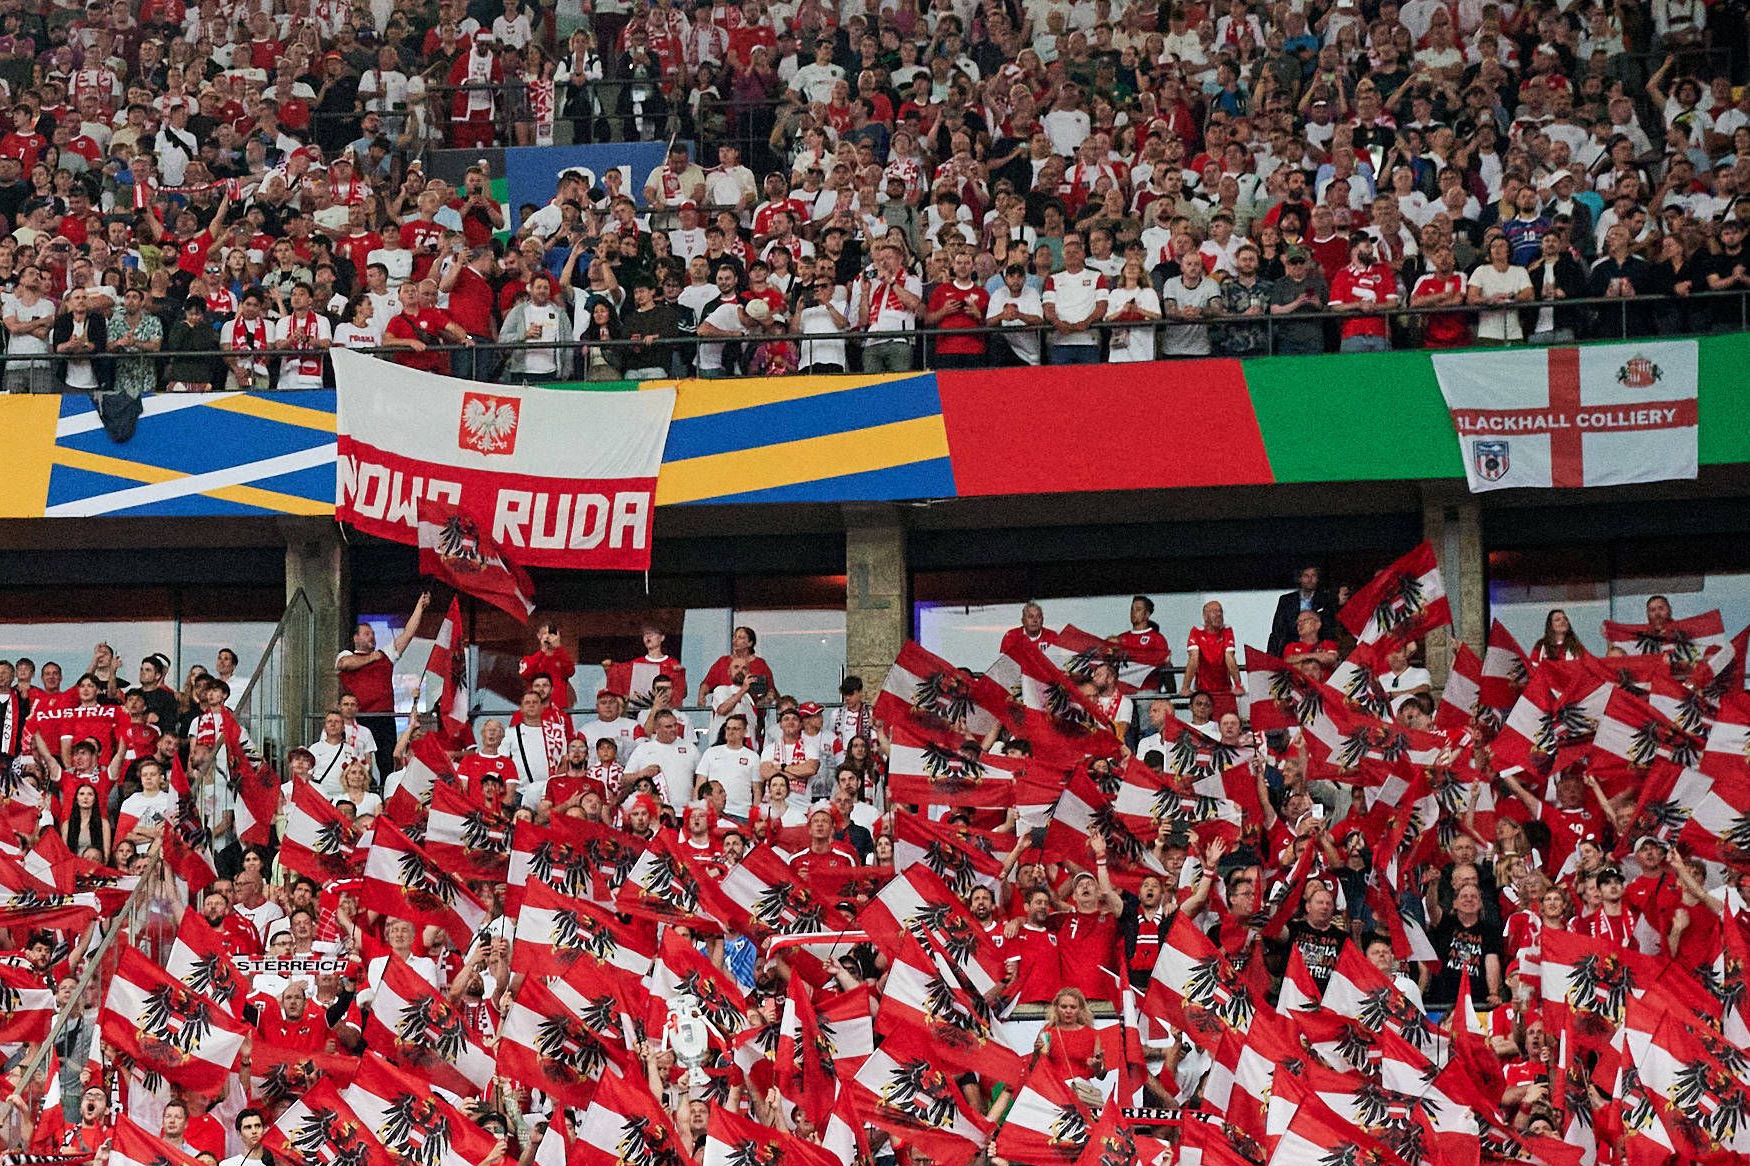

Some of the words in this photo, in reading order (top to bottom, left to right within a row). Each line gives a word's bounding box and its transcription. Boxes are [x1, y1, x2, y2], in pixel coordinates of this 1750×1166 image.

[1575, 407, 1677, 428] COLLIERY
[492, 488, 651, 550] RUDA
[36, 706, 114, 720] AUSTRIA
